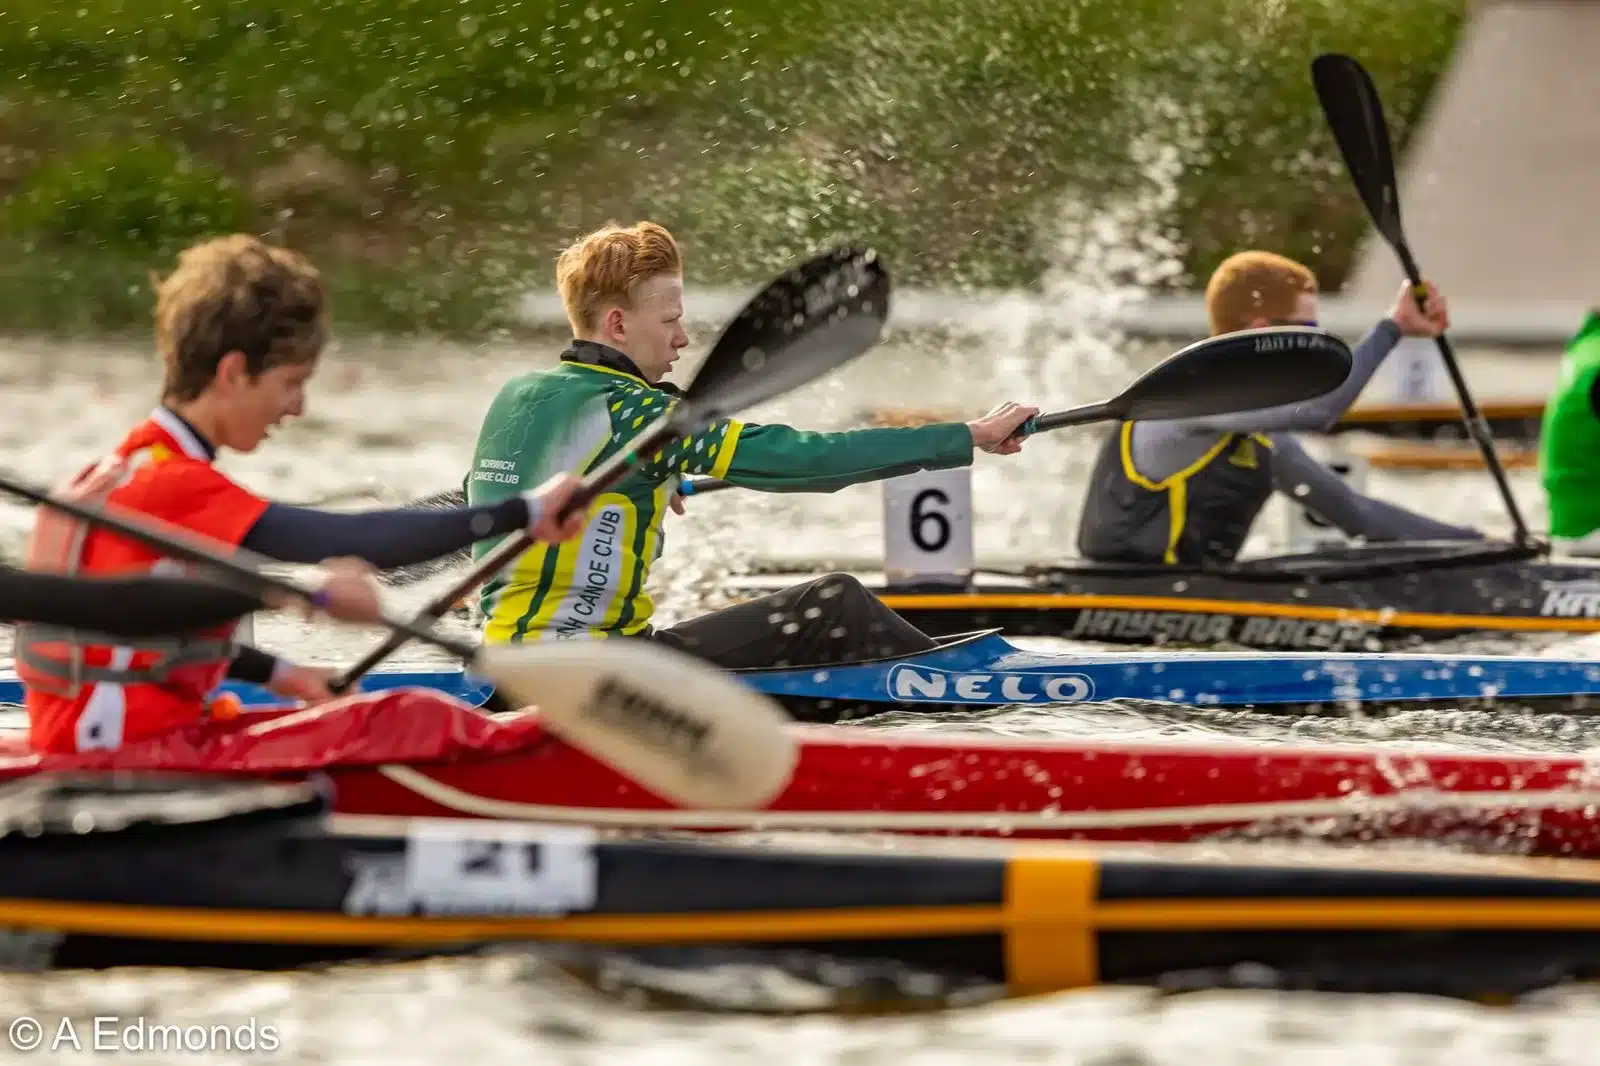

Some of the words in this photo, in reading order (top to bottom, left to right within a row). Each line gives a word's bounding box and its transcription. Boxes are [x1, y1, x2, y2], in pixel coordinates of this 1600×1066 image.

[480, 459, 516, 470] NORWICH
[494, 472, 519, 484] CLUB
[910, 488, 951, 553] 6
[573, 560, 610, 616] CANOE
[593, 510, 621, 557] CLUB
[896, 668, 1089, 701] NELO
[463, 841, 542, 877] 21
